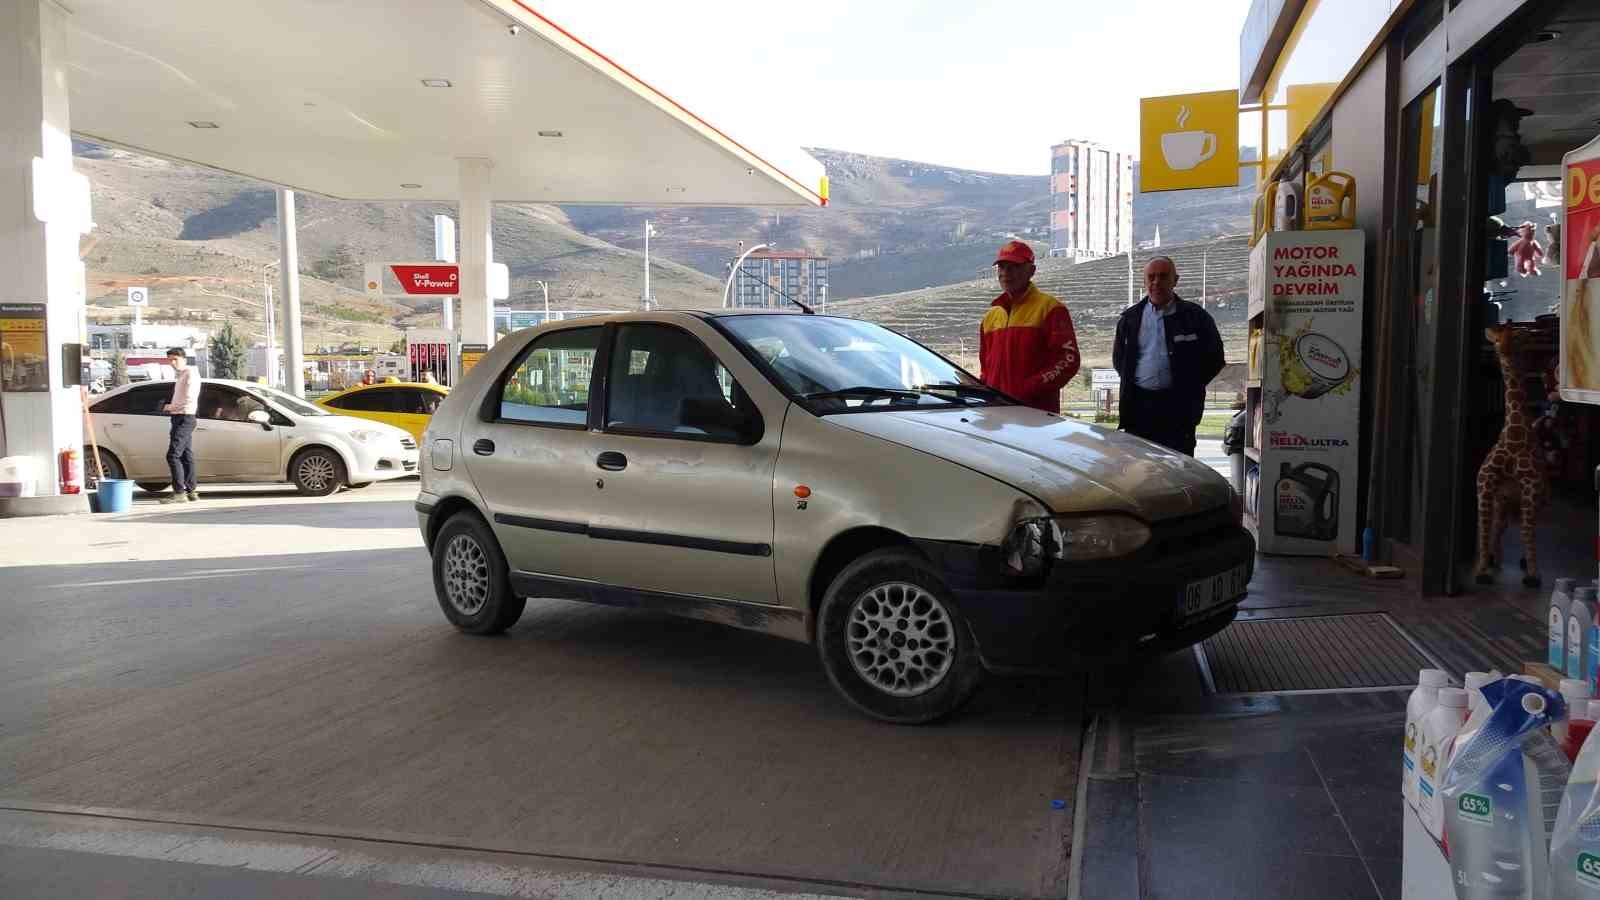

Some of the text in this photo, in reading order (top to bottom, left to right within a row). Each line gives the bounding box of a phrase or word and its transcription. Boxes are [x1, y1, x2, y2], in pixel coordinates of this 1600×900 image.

[1274, 246, 1339, 260] MOTOR
[1273, 261, 1358, 278] YAĞINDA
[414, 280, 454, 288] V-Power
[1273, 279, 1339, 296] DEVRİM
[1311, 438, 1349, 447] ULTRA
[1462, 797, 1488, 814] 65%
